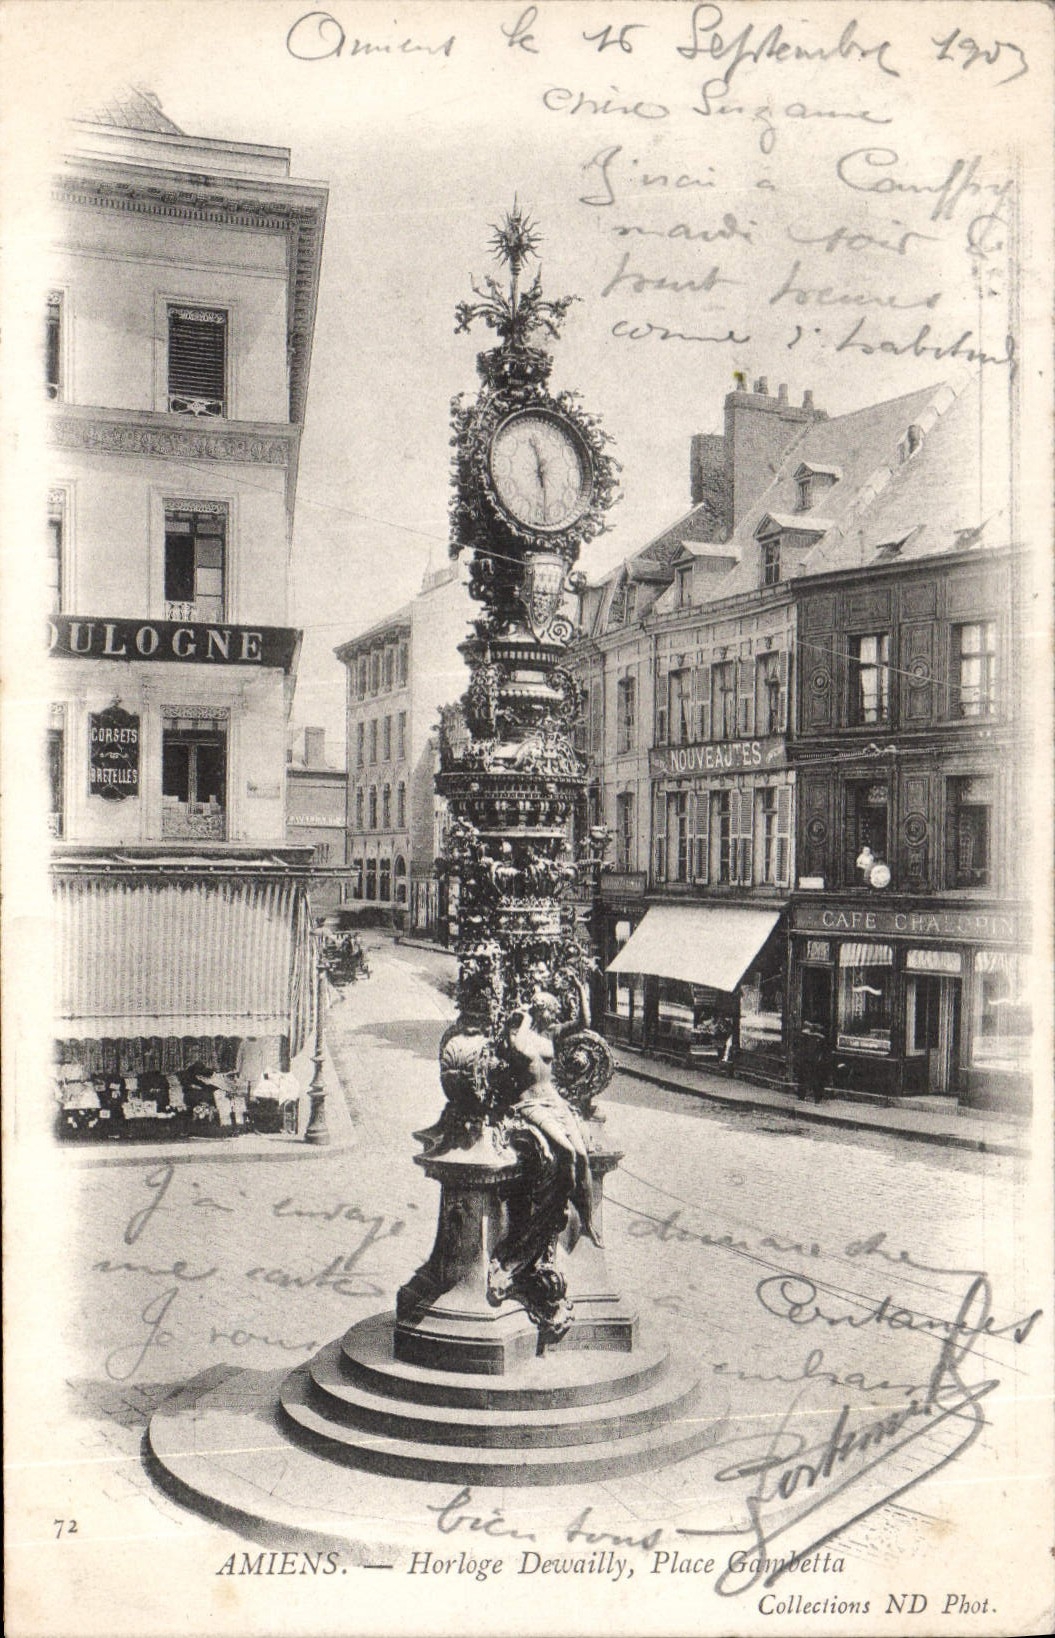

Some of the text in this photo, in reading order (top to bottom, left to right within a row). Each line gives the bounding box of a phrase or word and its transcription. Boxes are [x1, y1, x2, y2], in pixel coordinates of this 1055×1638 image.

[286, 11, 456, 61] Amiens
[501, 5, 540, 54] le
[677, 4, 900, 83] Septembre
[91, 727, 138, 744] CORSETS
[90, 768, 138, 784] BRETELLES
[822, 910, 877, 930] CAFE
